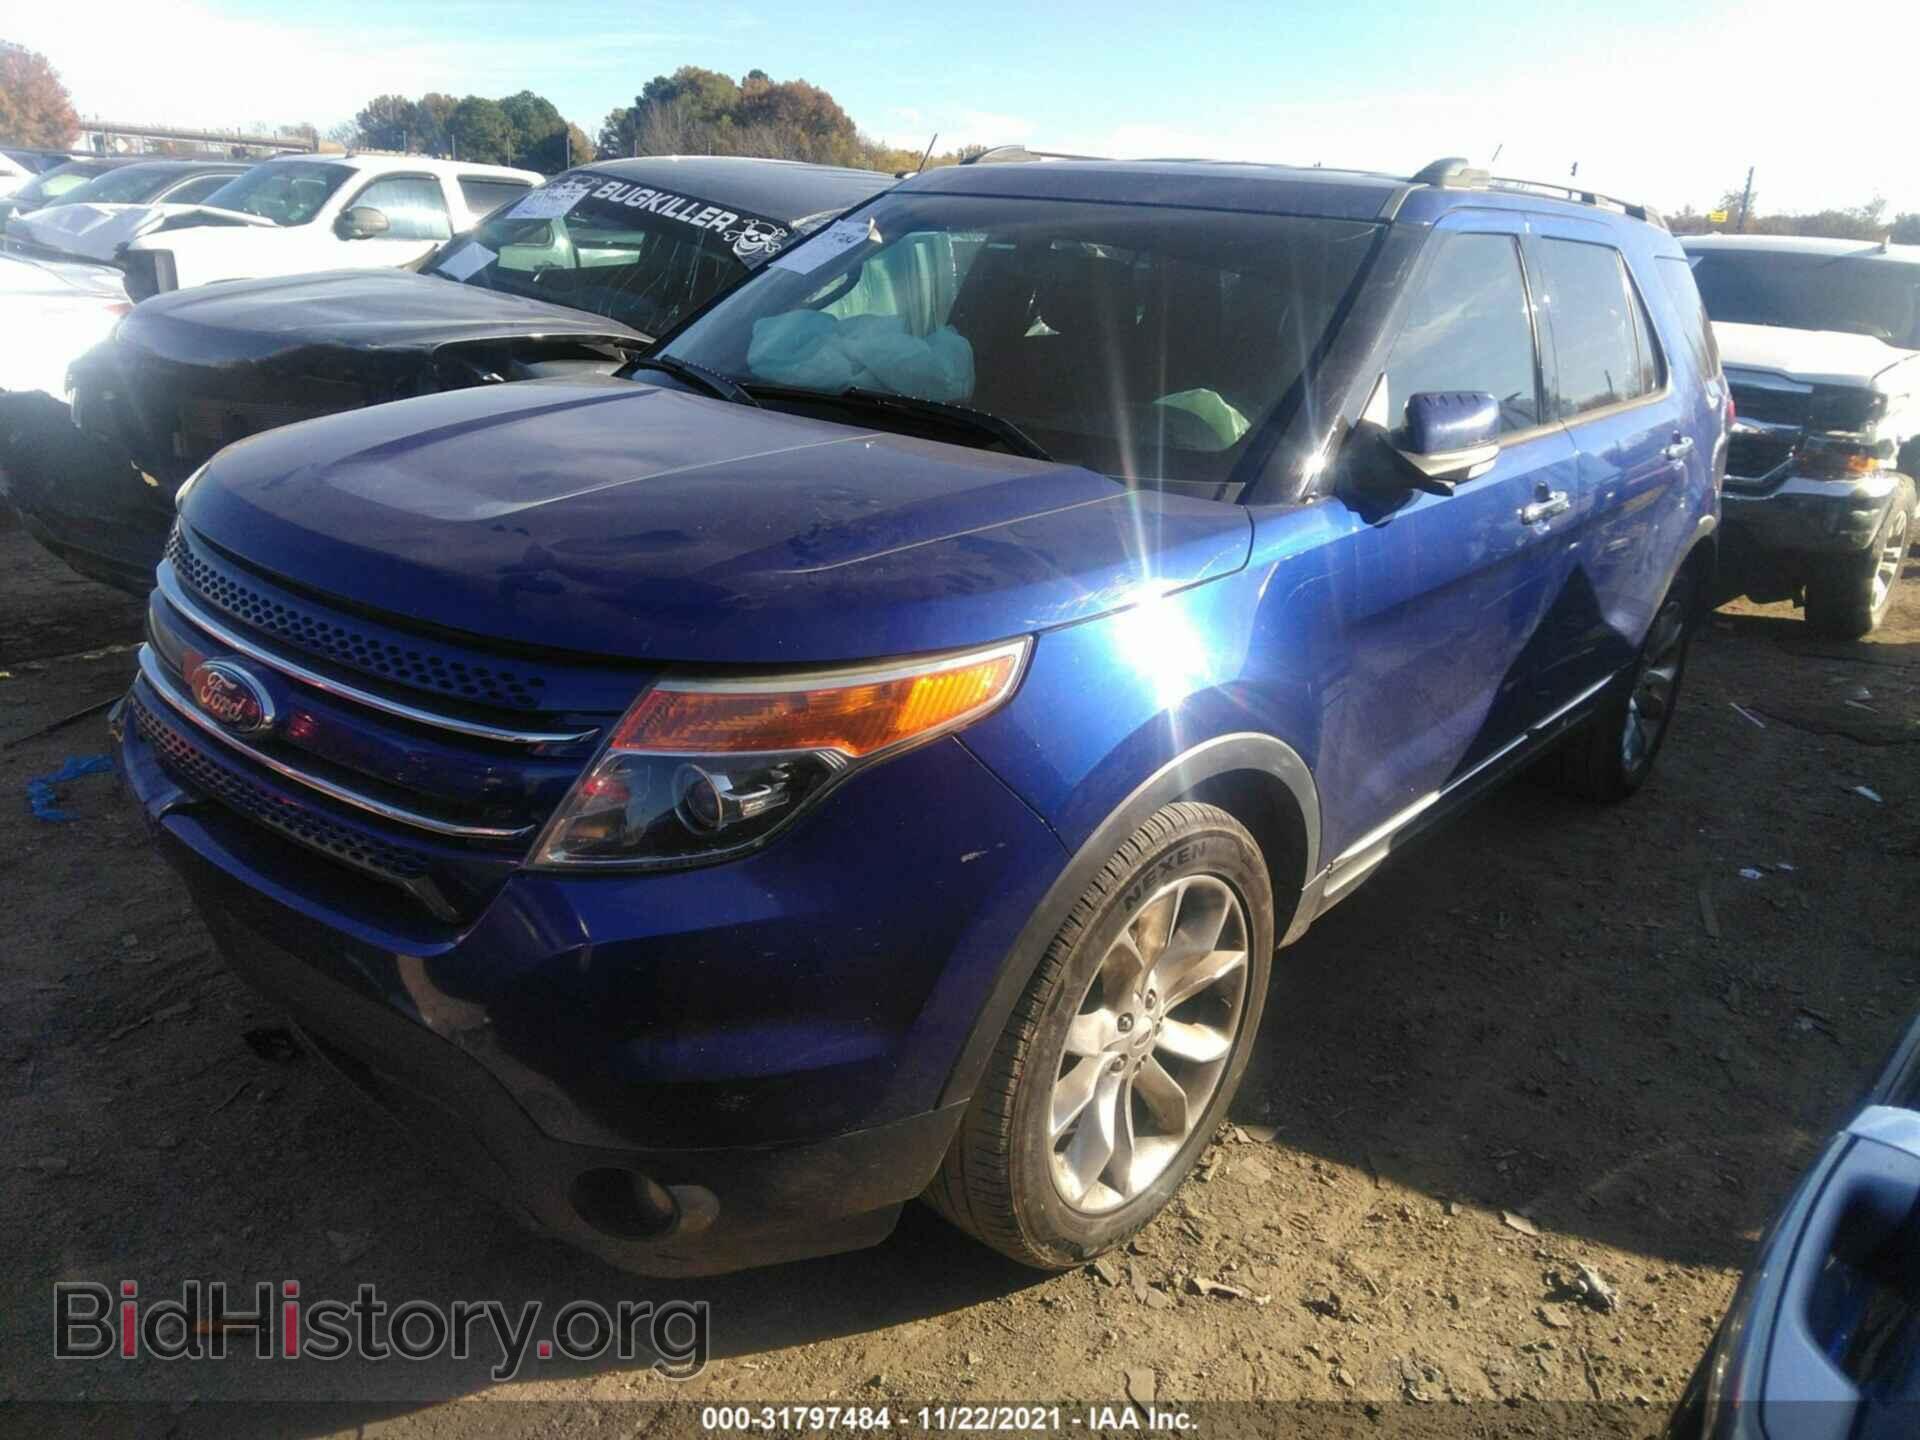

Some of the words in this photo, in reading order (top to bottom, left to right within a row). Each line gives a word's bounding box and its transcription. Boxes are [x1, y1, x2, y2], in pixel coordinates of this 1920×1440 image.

[591, 180, 739, 233] BUGKILLER
[201, 671, 247, 722] Ford
[1122, 840, 1207, 912] NEXEN
